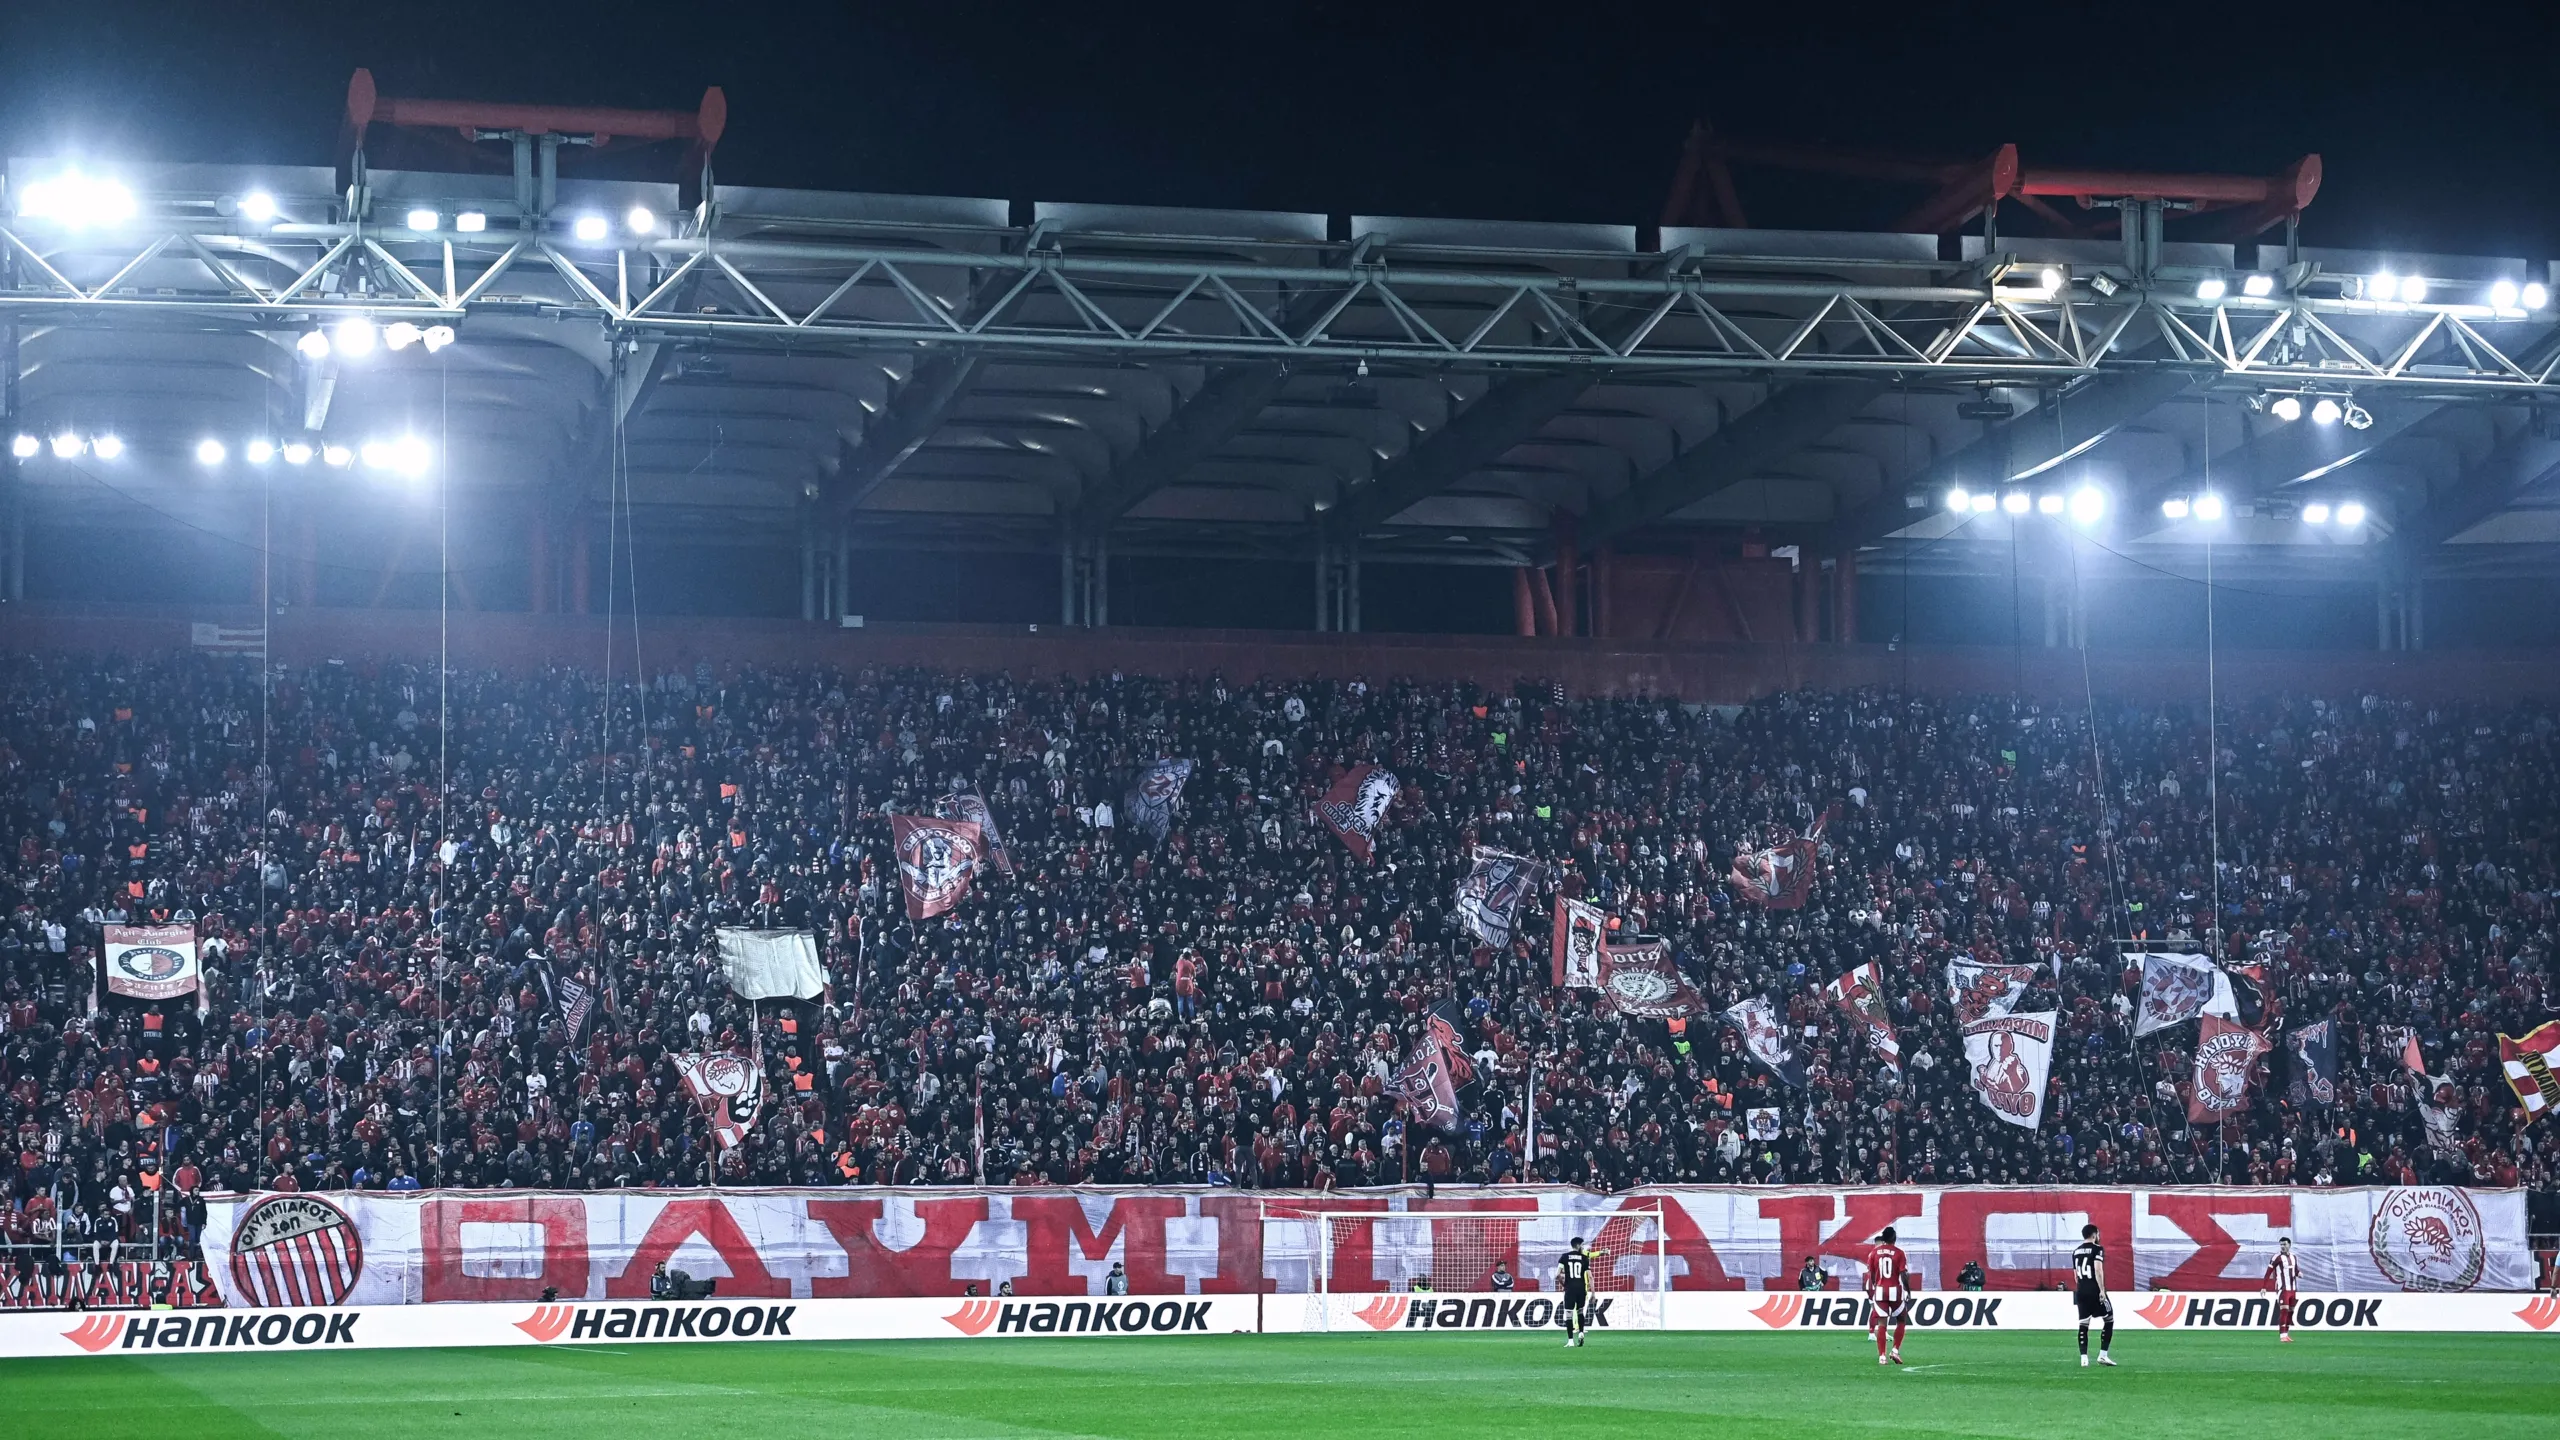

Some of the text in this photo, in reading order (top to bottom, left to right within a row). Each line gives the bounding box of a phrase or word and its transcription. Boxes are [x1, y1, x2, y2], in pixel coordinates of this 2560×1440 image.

[241, 1200, 331, 1246] ΟΛΥΜΠΙΑΚΟΣ
[2392, 1190, 2473, 1237] ΟΛΥΜΠΙΑΚΟΣ
[270, 1216, 301, 1236] ΣΦΠ
[420, 1194, 2291, 1302] ΟΛΥΜΠΙΑΚΟΣ
[1567, 1261, 1582, 1279] 10
[1878, 1256, 1893, 1279] 10
[2075, 1256, 2093, 1280] 44
